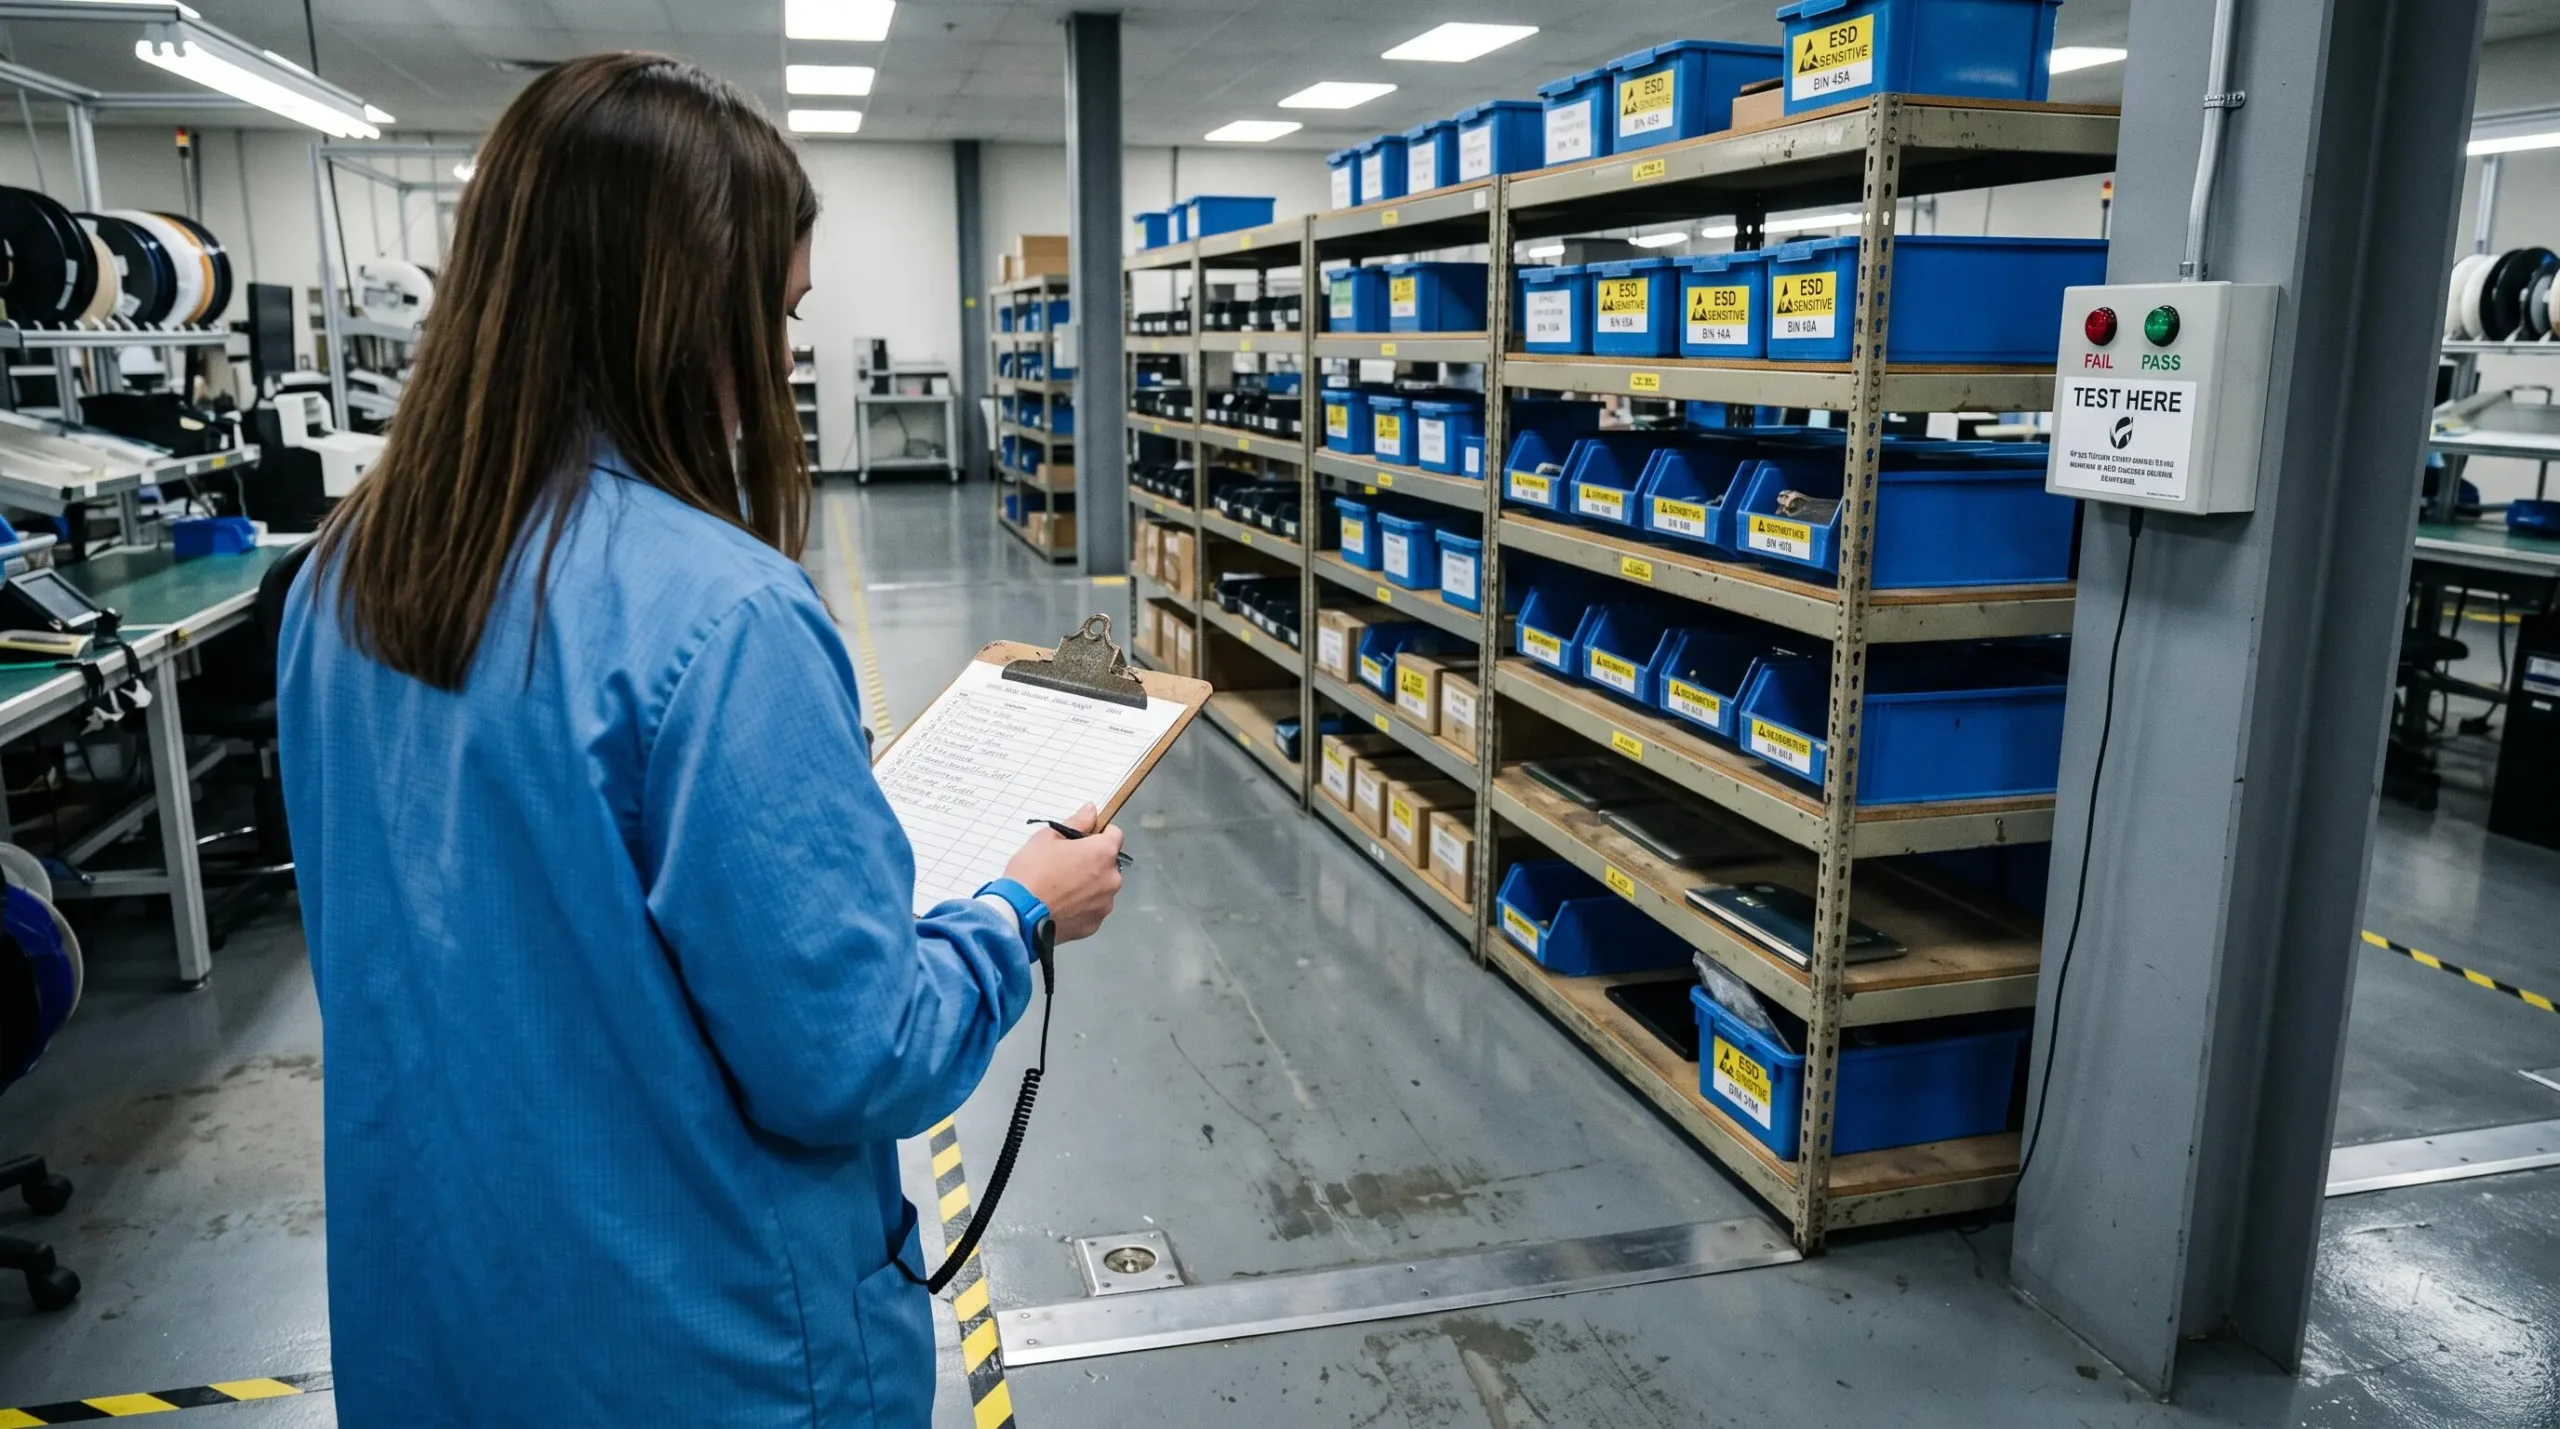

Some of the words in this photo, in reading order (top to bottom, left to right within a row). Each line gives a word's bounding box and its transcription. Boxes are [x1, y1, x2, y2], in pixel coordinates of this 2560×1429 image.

[1829, 25, 1858, 49] ESD
[1819, 44, 1868, 68] SENSITIVE
[1644, 77, 1664, 95] ESD
[1813, 76, 1830, 91] BIN
[1832, 70, 1850, 85] 45A
[1800, 277, 1824, 296] ESD
[1714, 290, 1736, 306] ESD
[1793, 297, 1833, 312] SENSITIVE
[1707, 309, 1745, 321] SENSITIVE
[1702, 328, 1715, 339] BIN
[1787, 320, 1800, 333] BIN
[2084, 353, 2114, 369] FAIL
[2141, 354, 2181, 371] PASS
[2074, 386, 2121, 409] TEST
[2126, 389, 2182, 413] HERE
